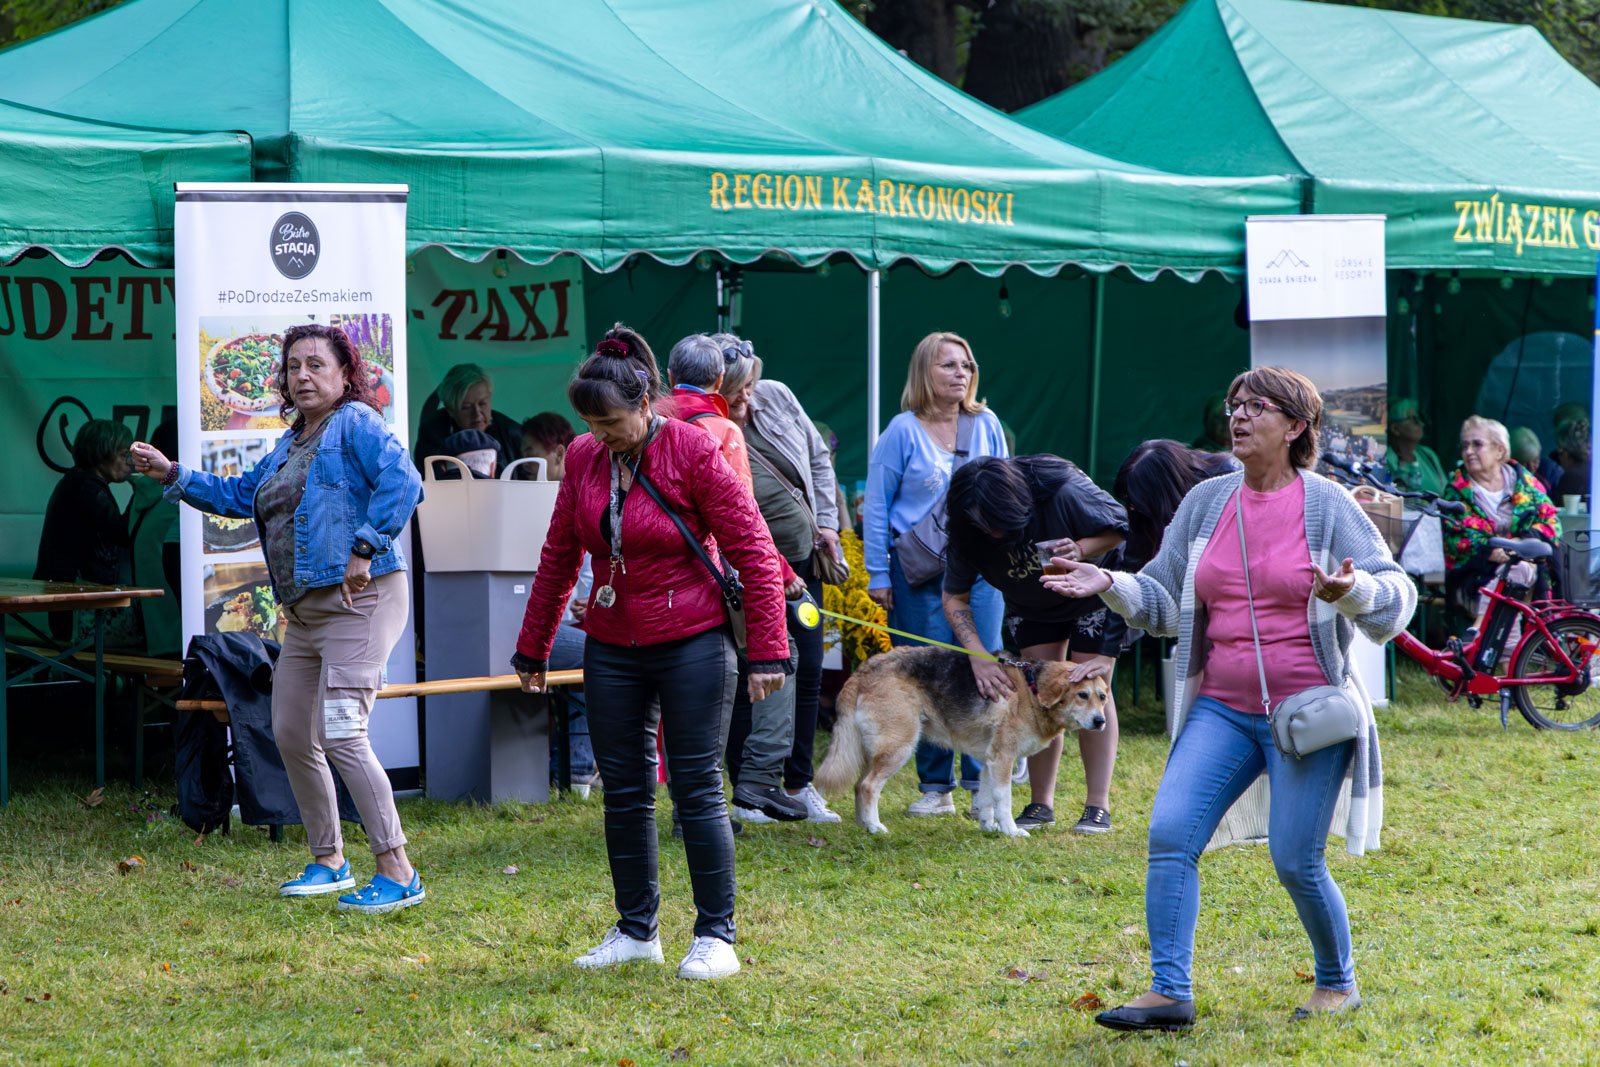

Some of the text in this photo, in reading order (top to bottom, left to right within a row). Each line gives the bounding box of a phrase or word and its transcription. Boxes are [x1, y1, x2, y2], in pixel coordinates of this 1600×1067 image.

[710, 172, 1015, 226] REGION KARKONOSKI
[1453, 191, 1579, 256] ZWIĄZEK
[275, 242, 316, 256] STACJA
[279, 222, 310, 241] Bistro
[0, 276, 177, 341] DET
[217, 289, 374, 304] #PoDrodzeZeSmakiem
[407, 279, 572, 342] -TAXI
